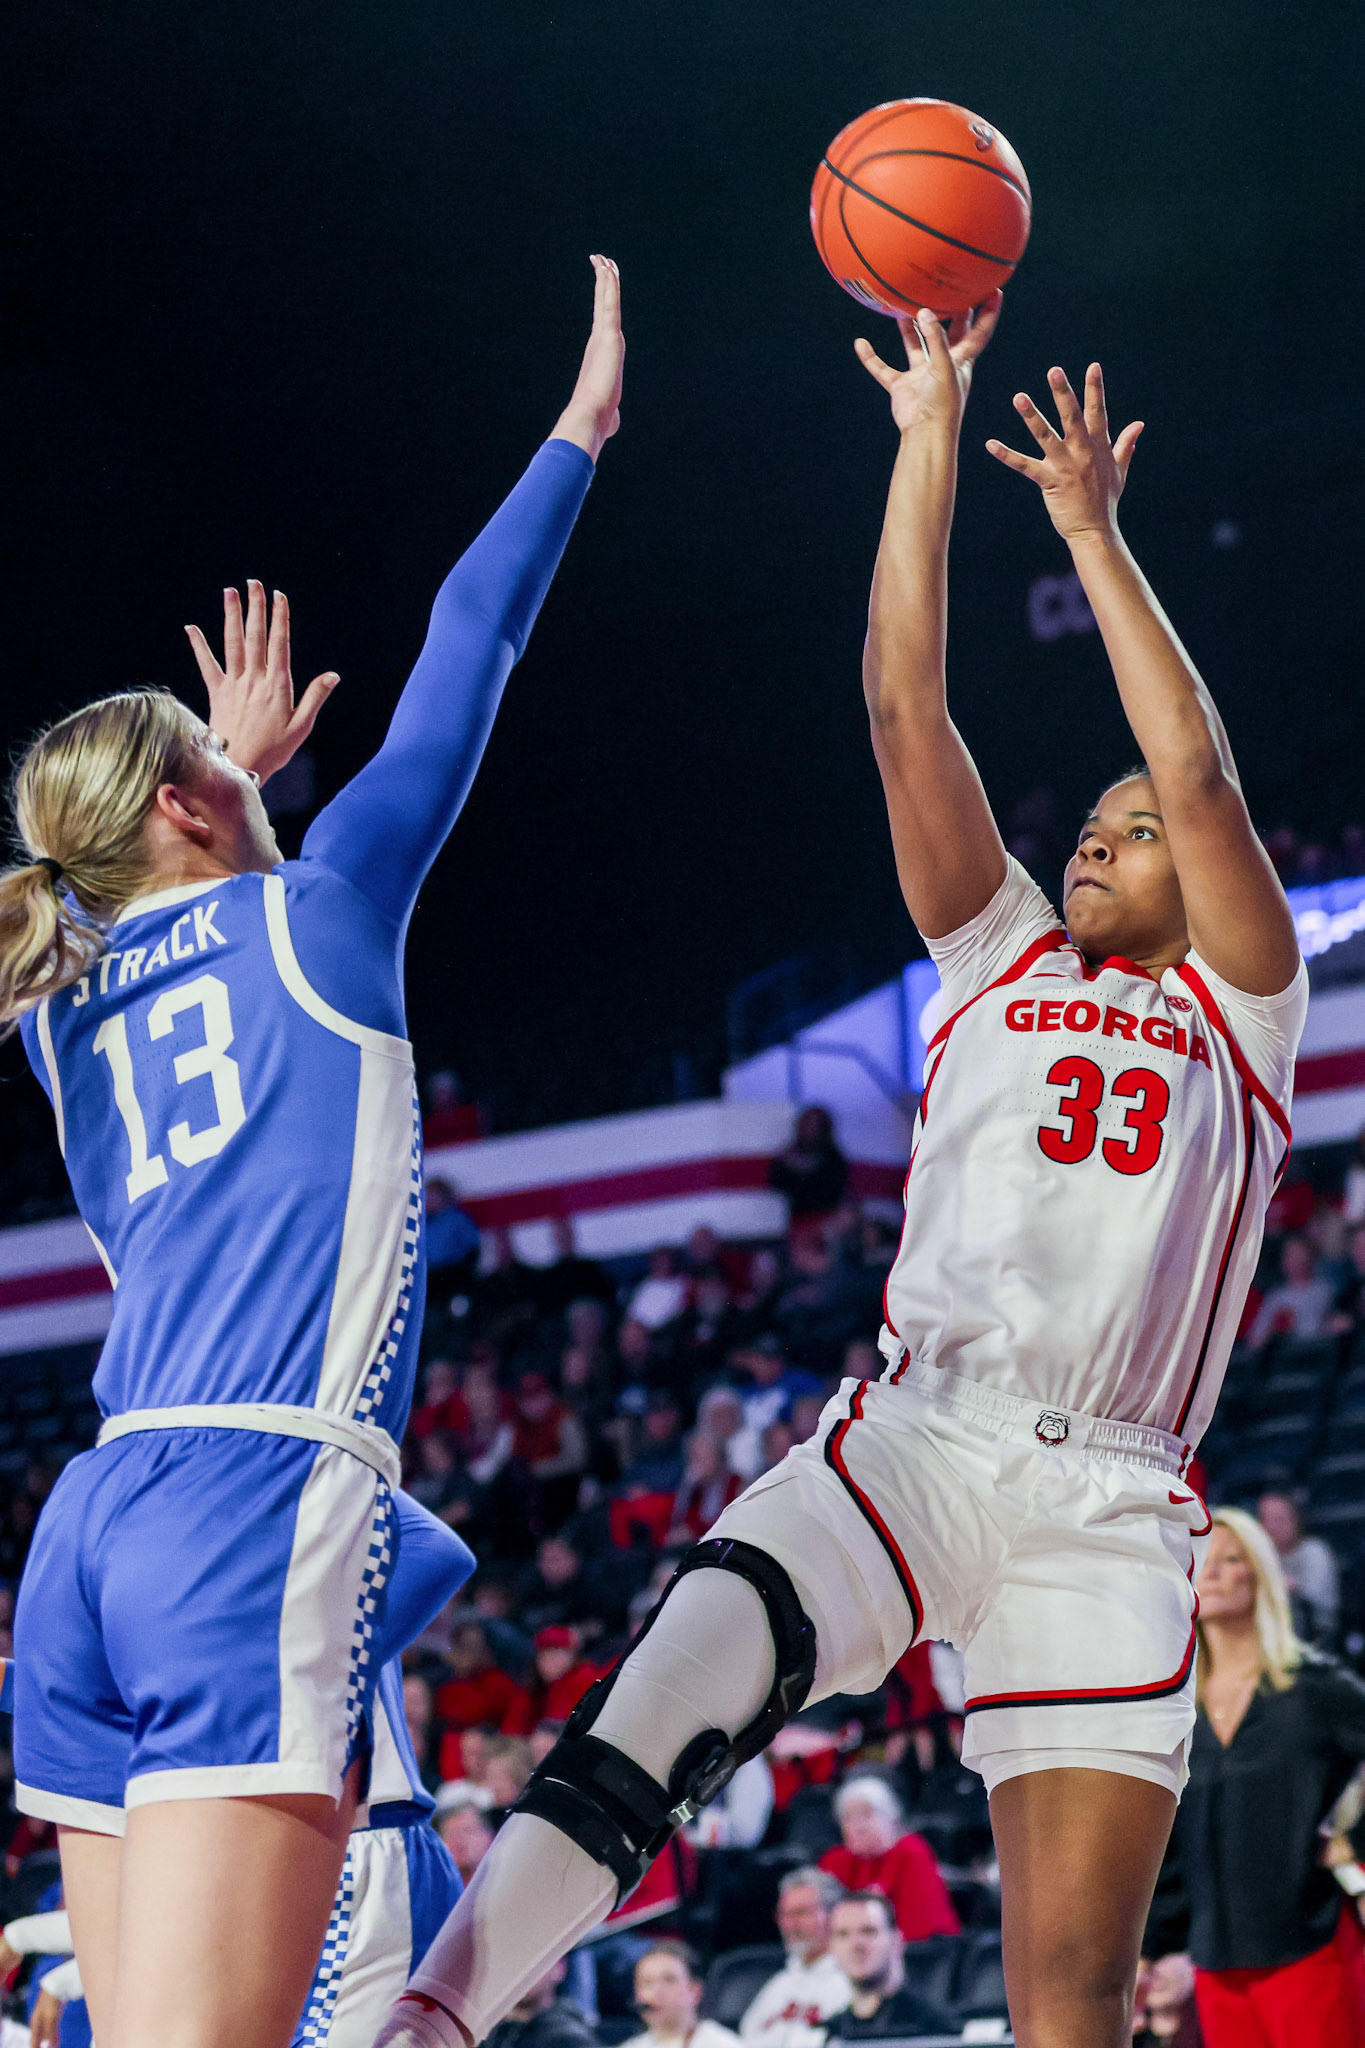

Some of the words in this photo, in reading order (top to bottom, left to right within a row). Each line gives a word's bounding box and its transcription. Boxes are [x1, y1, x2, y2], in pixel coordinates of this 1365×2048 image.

[92, 973, 246, 1204] 13
[1005, 999, 1213, 1071] GEORGIA
[1038, 1055, 1170, 1175] 33
